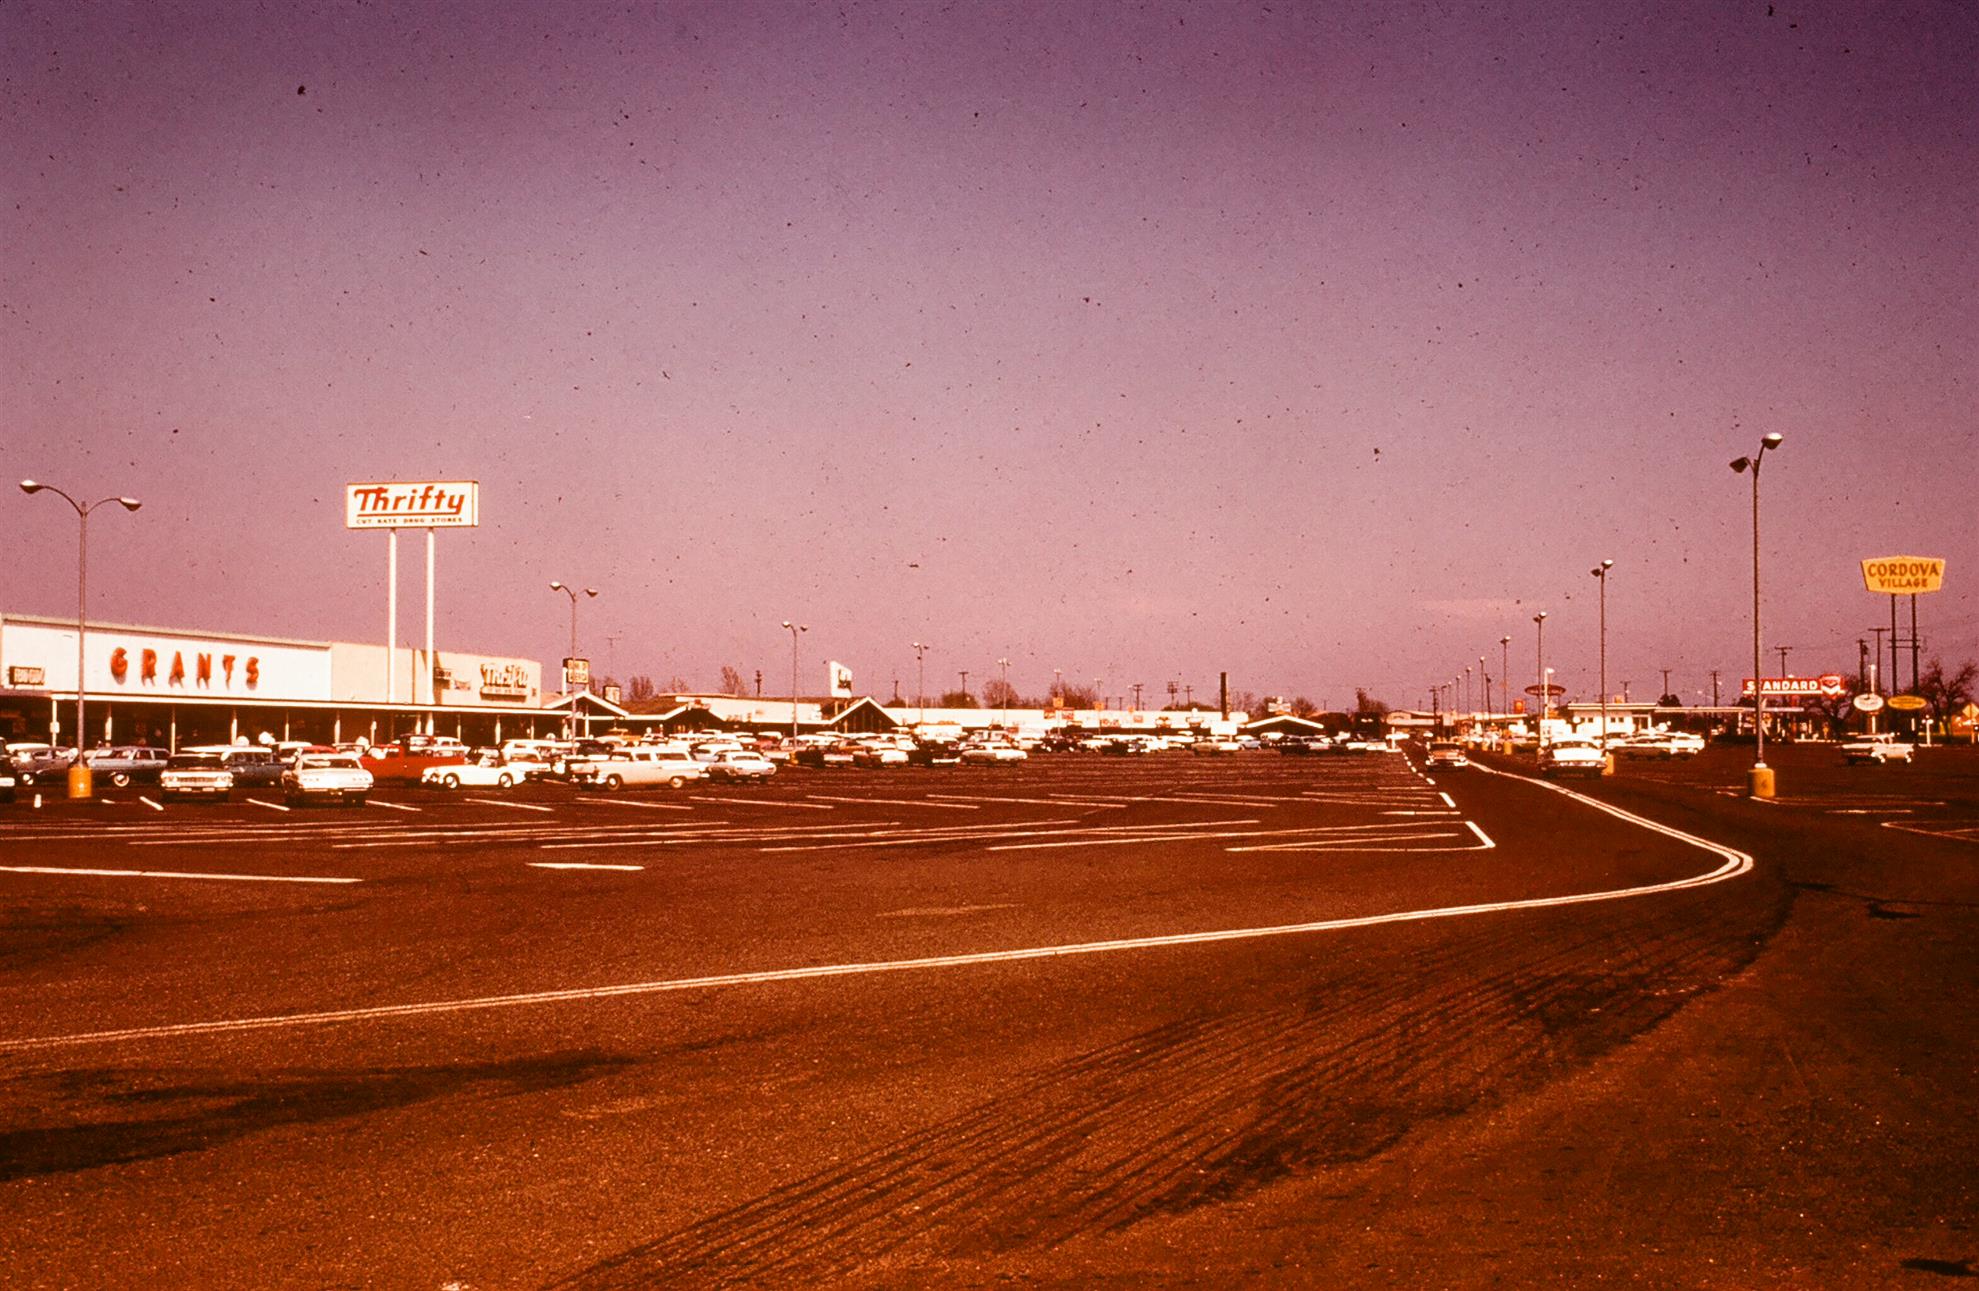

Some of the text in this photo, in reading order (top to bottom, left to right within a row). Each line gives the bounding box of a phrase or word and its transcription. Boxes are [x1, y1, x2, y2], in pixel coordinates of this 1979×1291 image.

[354, 485, 465, 514] Thrifty
[1867, 563, 1940, 577] CORDOVA
[1878, 578, 1929, 588] VILLAGE
[110, 646, 260, 687] GRANTS
[1746, 680, 1819, 691] SANDARD
